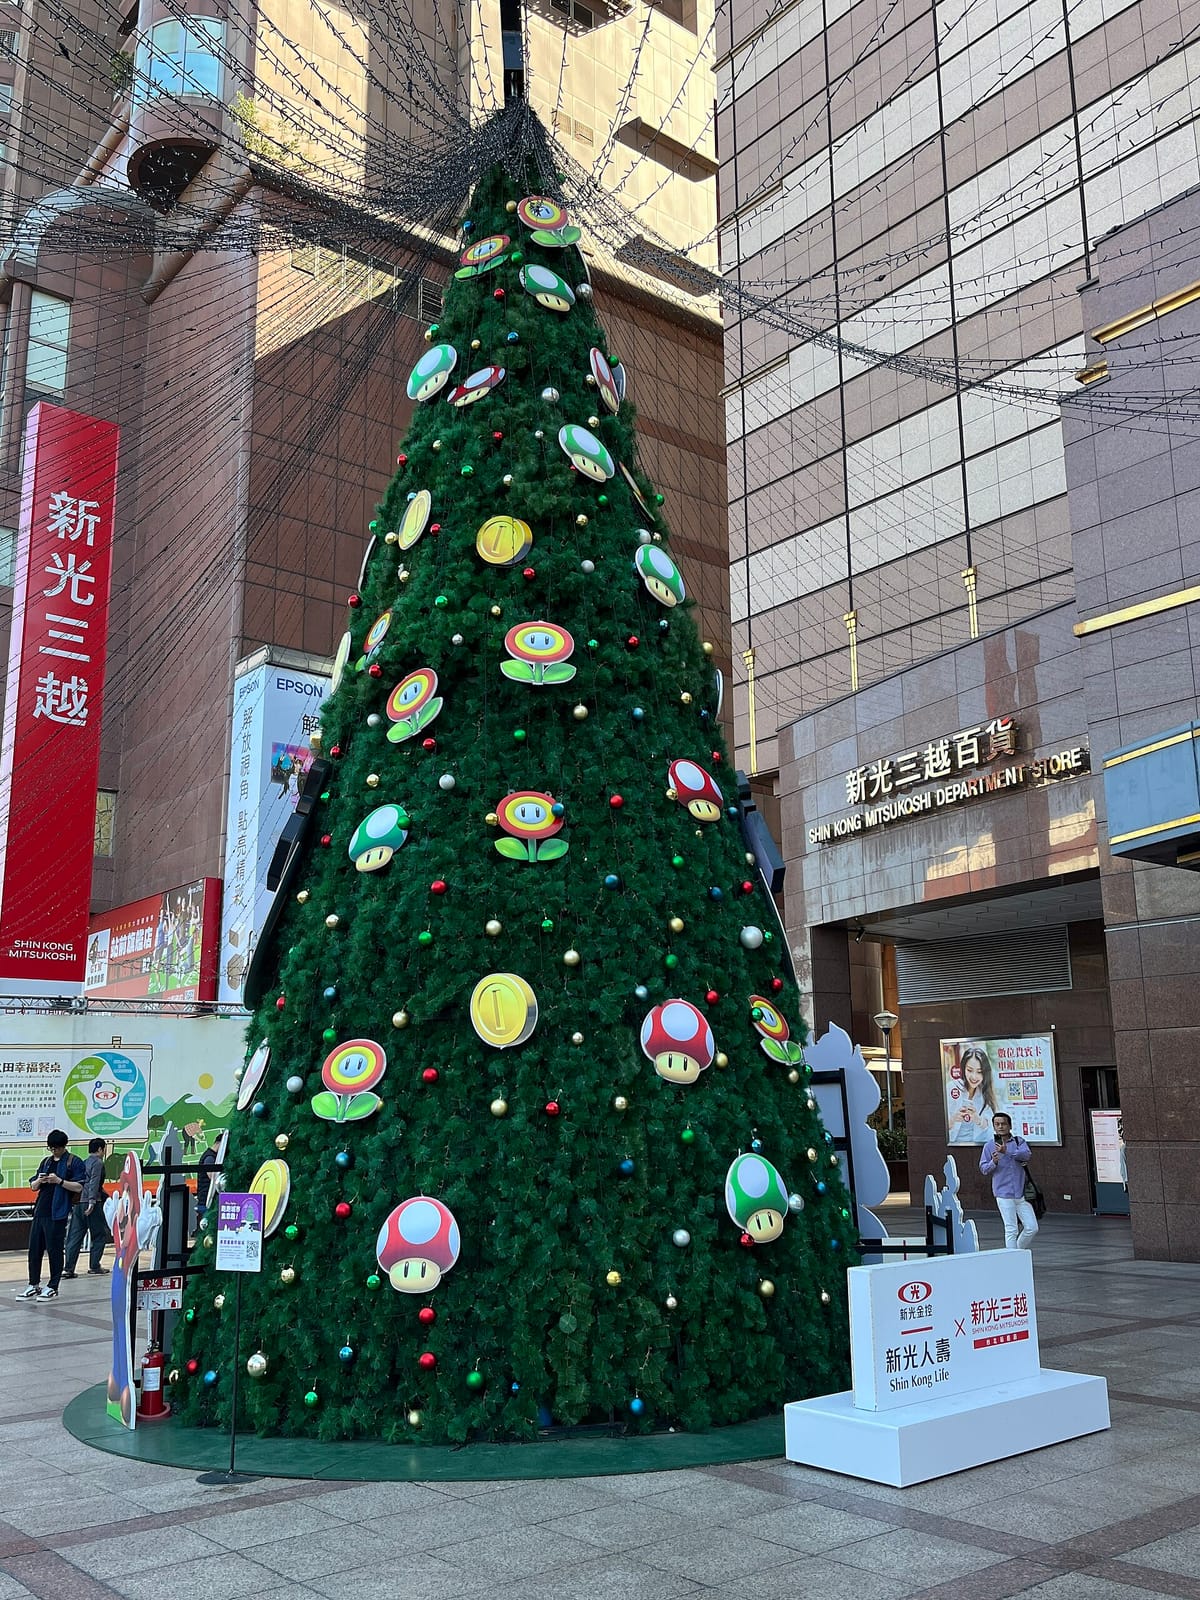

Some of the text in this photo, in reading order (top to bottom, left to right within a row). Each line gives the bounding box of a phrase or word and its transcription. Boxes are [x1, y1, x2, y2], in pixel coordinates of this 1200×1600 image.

[33, 491, 101, 727] 新光三越
[239, 679, 260, 699] EPSON
[276, 678, 323, 698] EPSON
[845, 716, 1017, 805] 新光三越百貨
[808, 747, 1082, 844] SHIN KONG MITSUKOSHI DEPARTMENT STORE
[9, 950, 77, 961] MITSUKOSHI
[14, 940, 74, 952] SHIN KONG
[0, 1062, 62, 1074] 田幸福餐桌
[899, 1303, 933, 1321] 新光金控
[970, 1292, 1028, 1326] 新光三越
[999, 1318, 1029, 1330] MITSUKOSHI
[885, 1337, 951, 1374] 新光人壽
[889, 1367, 951, 1393] Shin Kong Life
